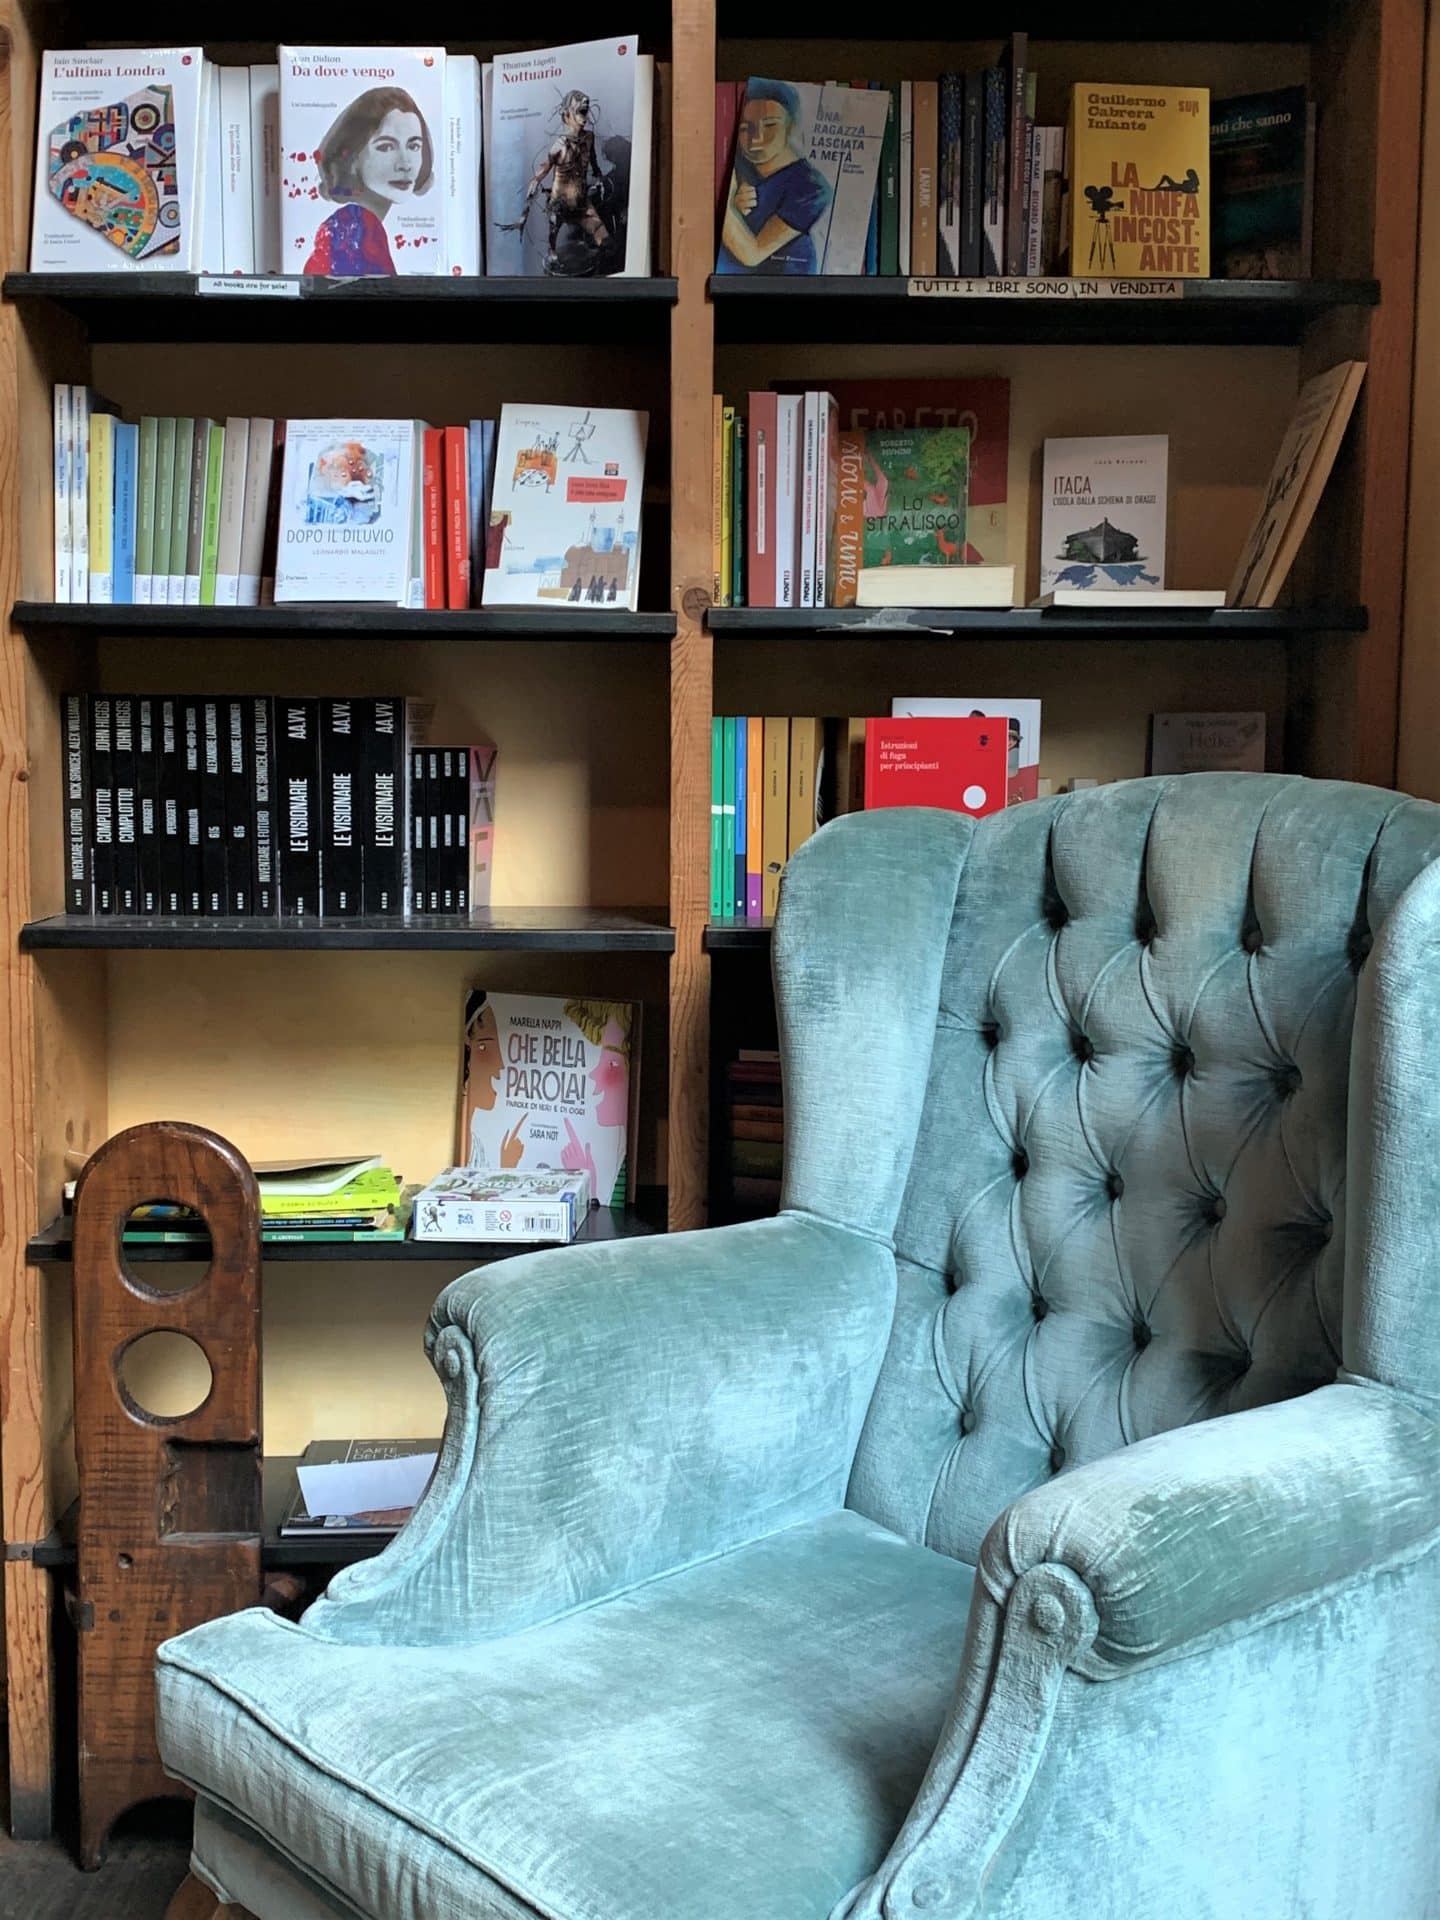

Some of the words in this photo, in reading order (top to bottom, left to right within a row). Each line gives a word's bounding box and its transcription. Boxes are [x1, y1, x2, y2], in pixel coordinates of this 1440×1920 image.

[54, 66, 112, 78] L'ultima
[117, 65, 166, 77] Londra
[292, 65, 311, 77] Da
[314, 65, 348, 77] dove
[352, 67, 395, 80] vengo
[502, 66, 562, 84] Nottuario
[1088, 94, 1166, 108] Guillermo
[816, 112, 840, 122] UNA
[1088, 106, 1155, 118] Cabrera
[814, 123, 864, 136] RAGAZZA
[1088, 118, 1147, 131] Infante
[1232, 116, 1253, 131] che
[1255, 112, 1292, 128] sanno
[812, 136, 864, 150] LASCIATA
[809, 149, 816, 160] A
[1111, 161, 1140, 188] LA
[920, 167, 932, 208] LANARK
[1129, 191, 1200, 218] NINFA
[1113, 217, 1200, 244] INCOST-
[1140, 245, 1200, 274] ANTE
[913, 280, 960, 292] TUTTI
[966, 280, 974, 292] I
[986, 280, 1020, 293] IBRI
[1026, 281, 1069, 294] SONO
[1080, 282, 1098, 294] IN
[1110, 282, 1176, 294] VENDITA
[1054, 476, 1092, 494] ITACA
[902, 495, 923, 512] LO
[1076, 496, 1096, 506] DALLA
[866, 514, 960, 532] STRALISCO
[286, 528, 323, 544] DOPO
[327, 528, 338, 544] IL
[343, 528, 394, 544] DILUVIO
[839, 531, 860, 591] rime
[94, 700, 110, 728] HIGGS
[116, 700, 132, 728] HIGGS
[288, 706, 307, 740] AA.VV.
[332, 700, 350, 734] AA.VV.
[376, 702, 394, 734] AA.VV.
[68, 732, 81, 750] ALEX
[96, 728, 111, 752] JOHN
[116, 728, 132, 752] JOHN
[256, 734, 268, 752] ALEX
[880, 740, 918, 750] Istruzioni
[206, 739, 218, 774] ALEXANDRE
[232, 738, 243, 774] ALEXANDRE
[880, 752, 888, 760] di
[890, 752, 907, 761] fuga
[880, 763, 893, 772] per
[894, 761, 940, 772] principianti
[70, 782, 82, 800] NICK
[256, 784, 268, 802] NICK
[288, 777, 308, 839] VISIONARIE
[332, 772, 352, 834] VISIONARIE
[376, 772, 394, 834] VISIONARIE
[70, 808, 83, 836] FUTURO
[96, 788, 112, 843] COMPLOTTO!
[118, 788, 134, 843] COMPLOTTO!
[256, 810, 270, 838] FUTURO
[290, 840, 308, 852] LE
[333, 834, 352, 846] LE
[376, 835, 394, 847] LE
[72, 843, 84, 880] INVENTARE
[258, 844, 272, 882] INVENTARE
[510, 1016, 540, 1028] MARELLA
[508, 1032, 538, 1064] CHE
[542, 1035, 586, 1068] BELLA
[506, 1066, 586, 1106] PAROLA!
[506, 1100, 528, 1110] PAROLE
[530, 1102, 538, 1110] DI
[560, 1106, 568, 1114] DI
[568, 1107, 586, 1116] OGGI
[530, 1128, 545, 1138] SARA
